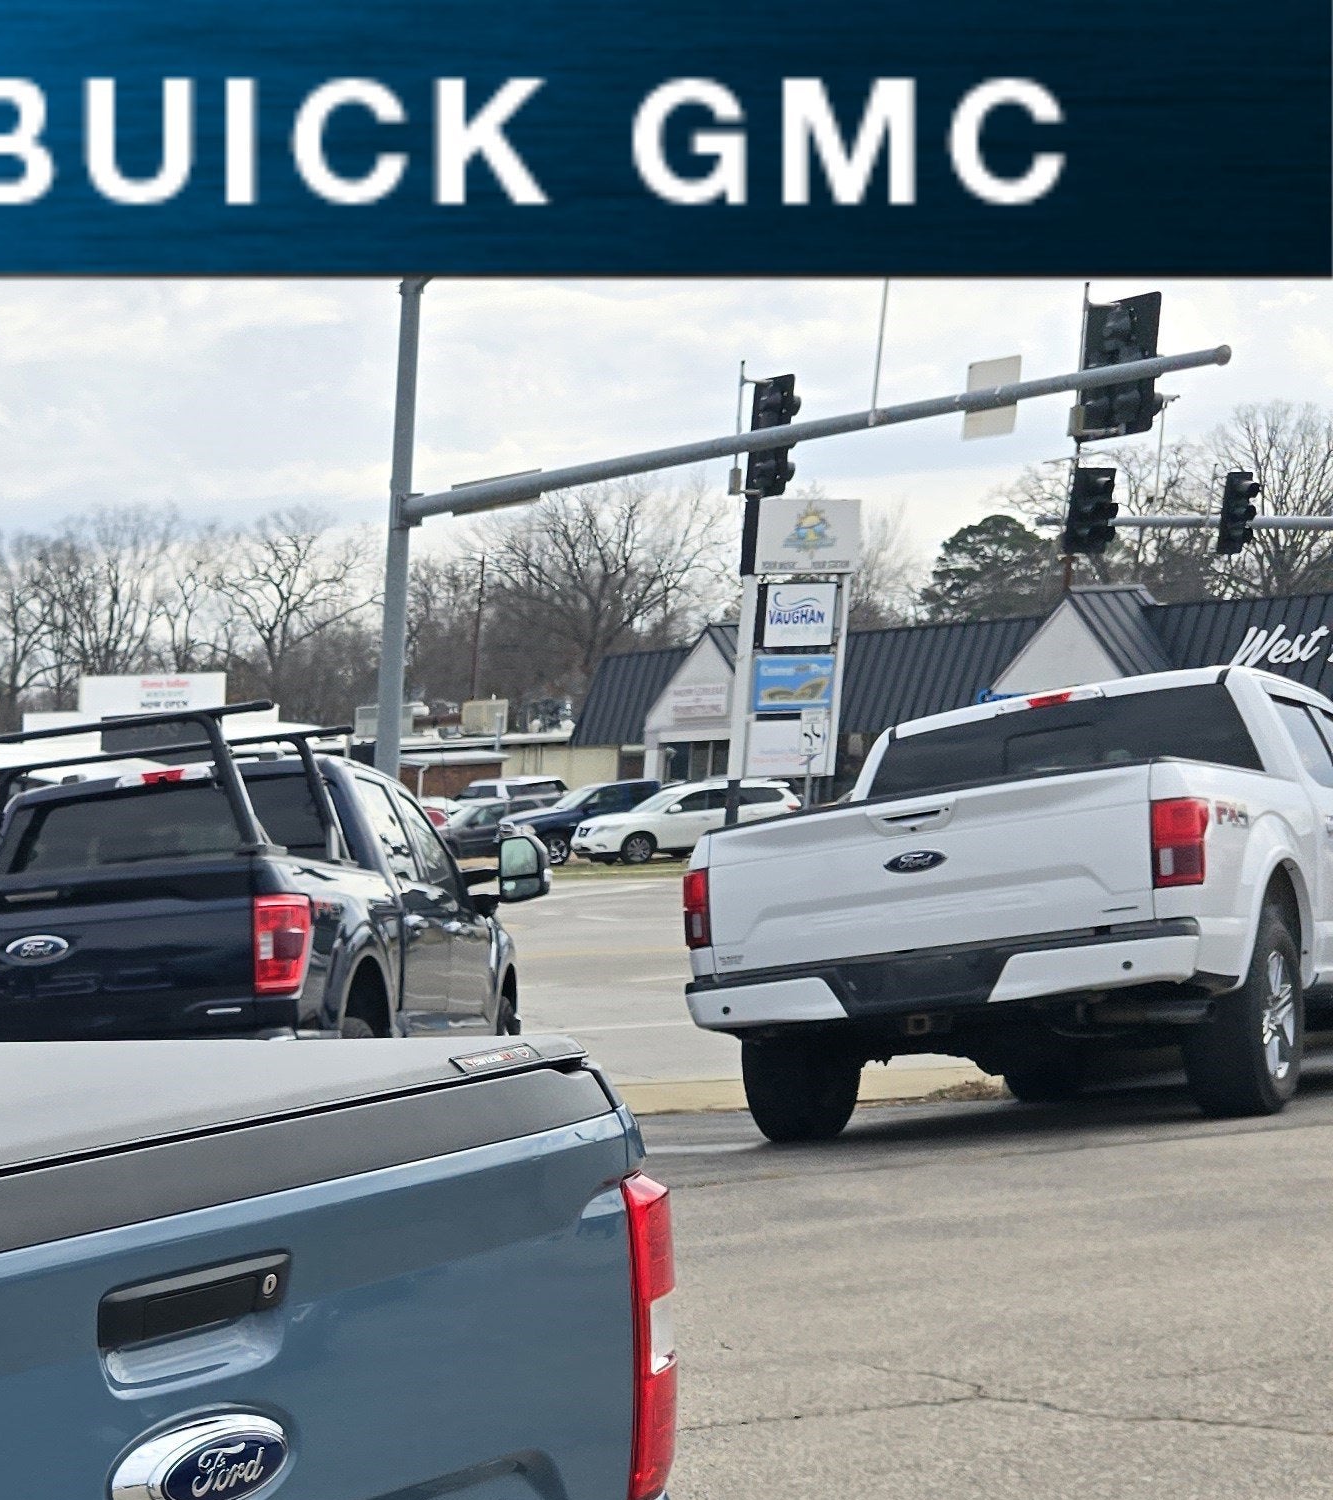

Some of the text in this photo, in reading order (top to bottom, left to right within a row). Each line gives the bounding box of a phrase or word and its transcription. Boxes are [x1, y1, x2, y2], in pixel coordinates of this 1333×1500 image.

[768, 609, 825, 625] VAUGHAN
[1228, 623, 1330, 668] West
[164, 699, 190, 708] OPEN
[190, 1441, 266, 1498] Ford
